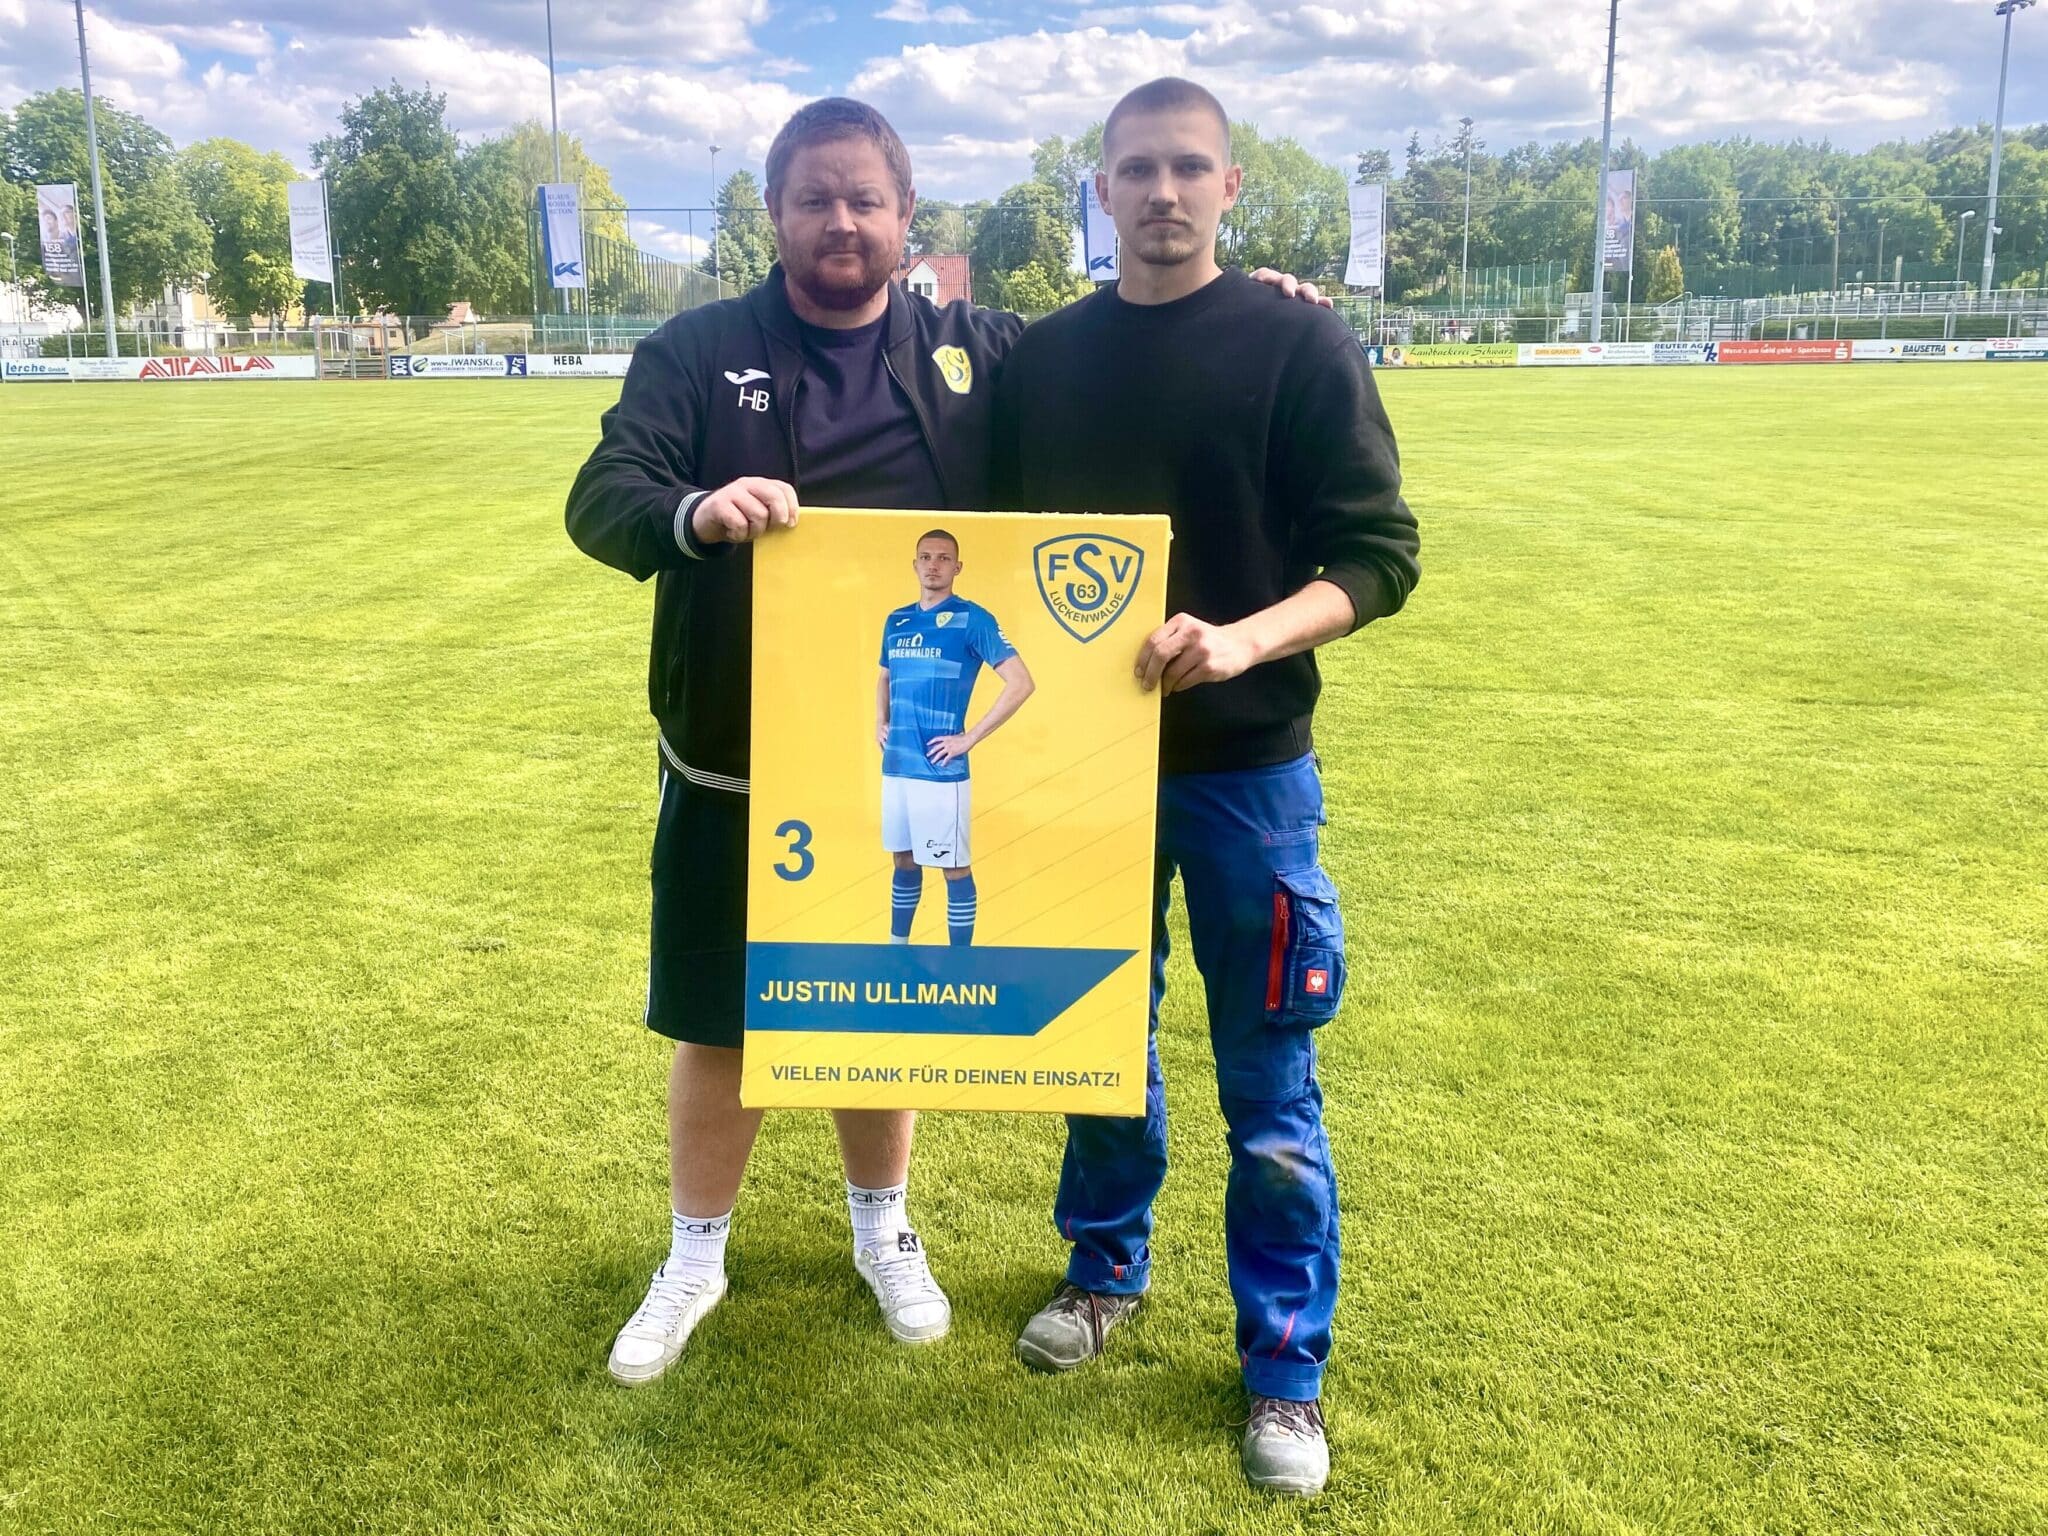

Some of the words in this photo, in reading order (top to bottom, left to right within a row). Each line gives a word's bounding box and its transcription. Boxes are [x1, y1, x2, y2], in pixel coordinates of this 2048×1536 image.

[6, 362, 46, 376] Lerche
[553, 355, 583, 366] HEBA
[738, 386, 770, 412] HB
[1077, 584, 1097, 599] 63
[1050, 591, 1125, 623] LUCKENWALDE
[897, 638, 912, 647] DIE
[773, 819, 815, 882] 3
[760, 980, 856, 1003] JUSTIN
[865, 982, 997, 1006] ULLMANN
[771, 1065, 841, 1082] VIELEN
[847, 1066, 903, 1083] DANK
[909, 1064, 948, 1084] FÜR
[954, 1069, 1027, 1086] DEINEN
[1033, 1070, 1121, 1088] EINSATZ!
[850, 1190, 903, 1203] alvin
